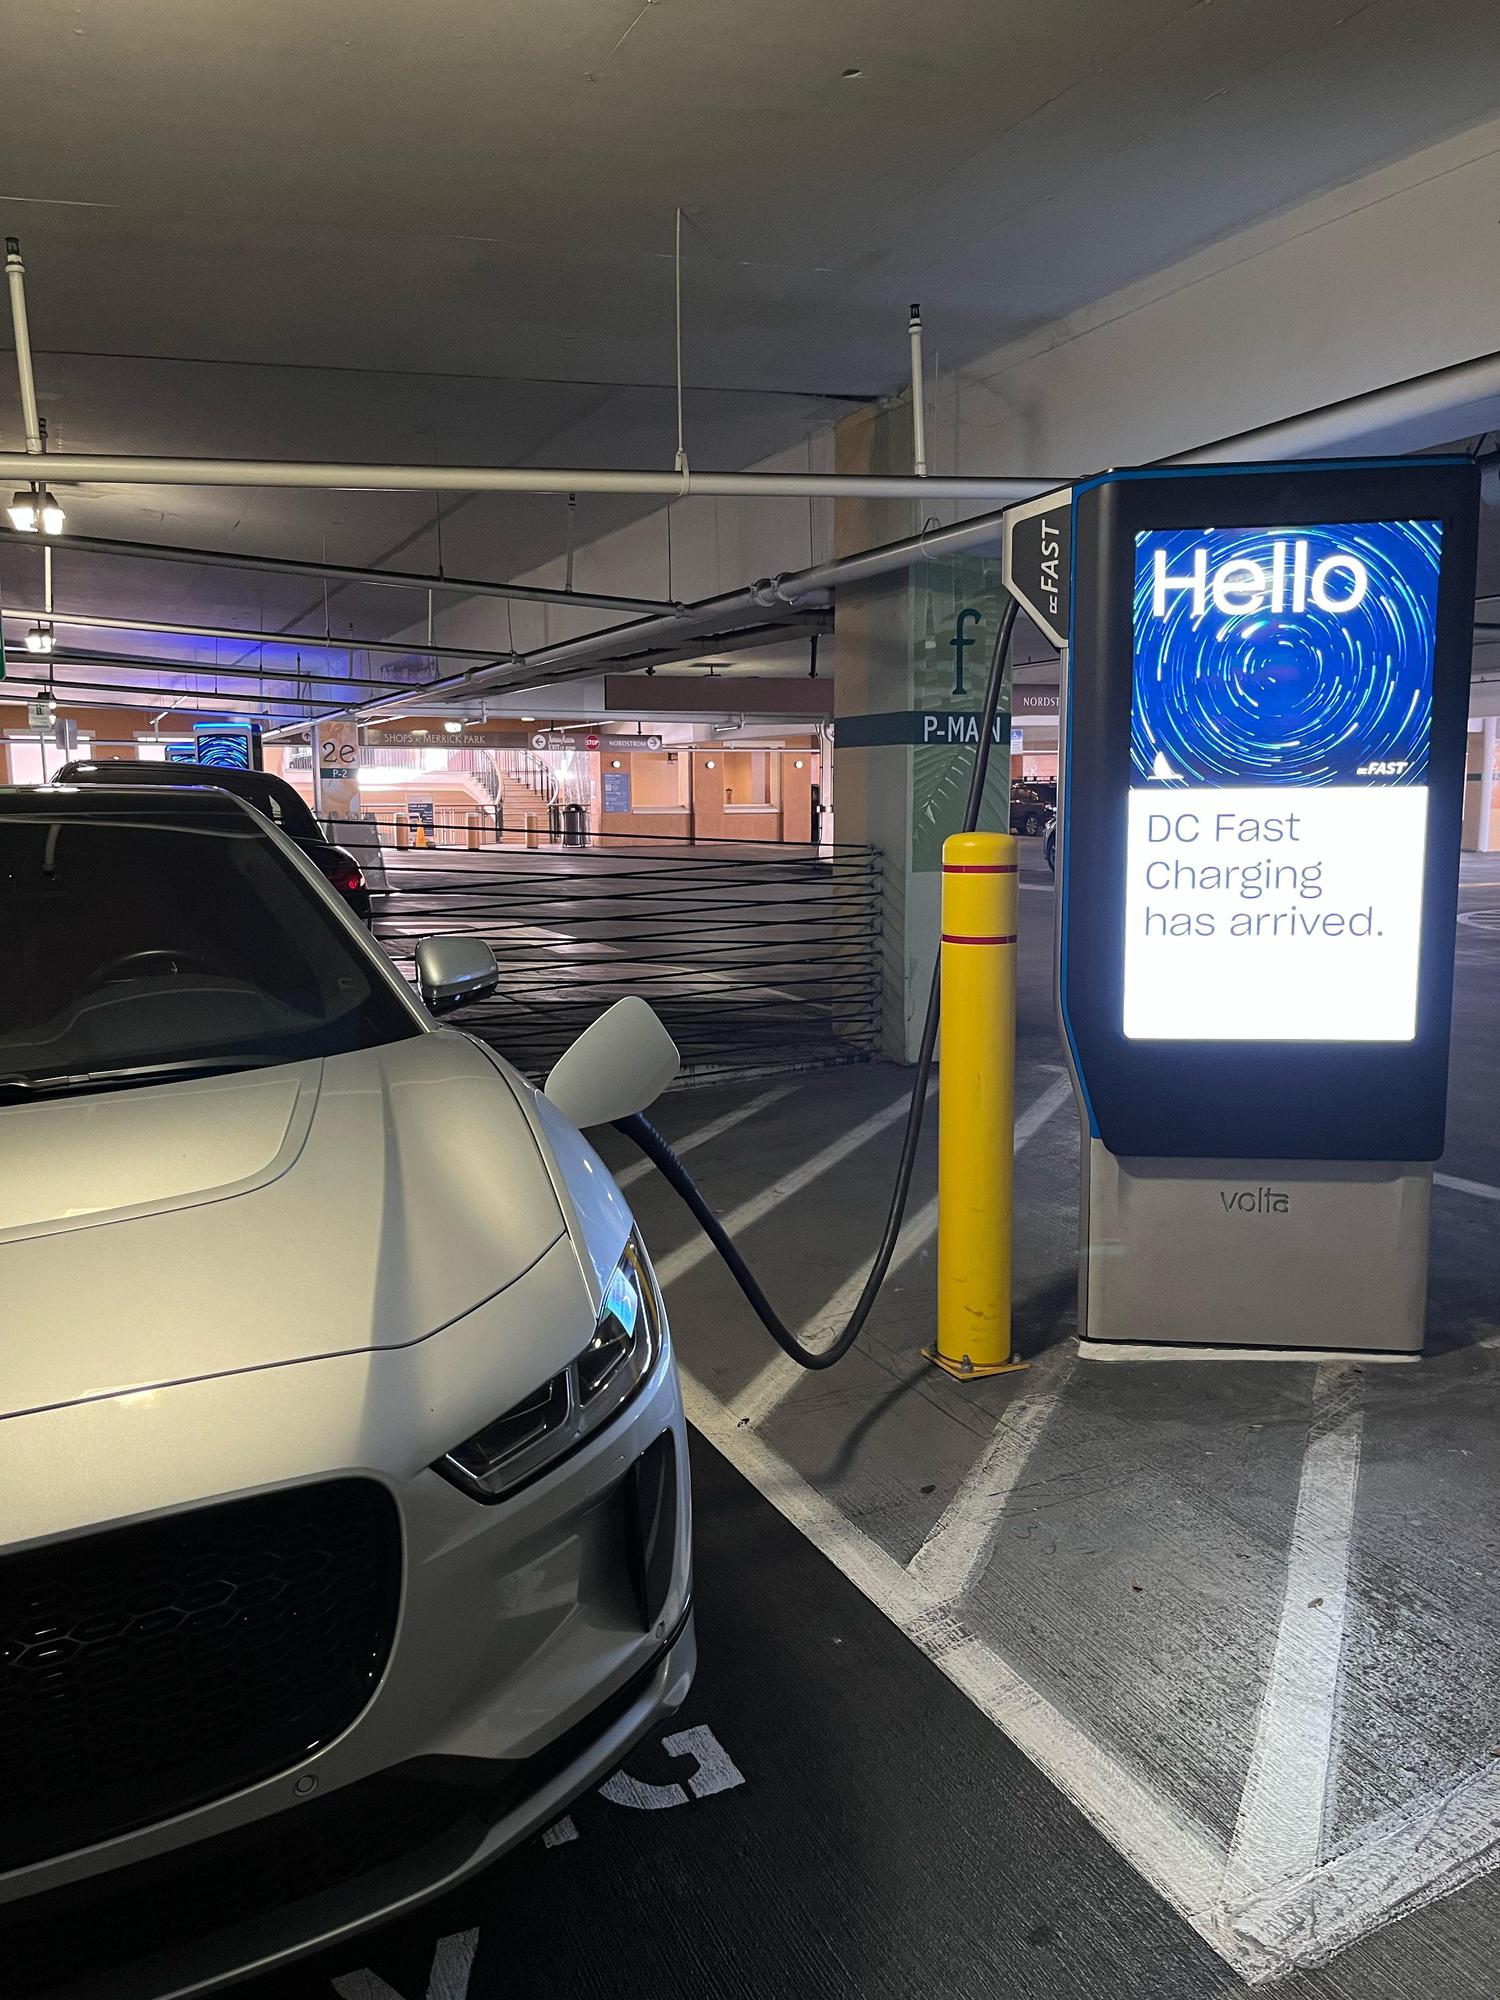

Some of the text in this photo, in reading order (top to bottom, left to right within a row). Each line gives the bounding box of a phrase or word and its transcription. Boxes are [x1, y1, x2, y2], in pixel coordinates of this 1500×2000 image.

[1040, 519, 1060, 593] FAST
[1152, 540, 1369, 617] Hello
[384, 733, 413, 743] SHOPS
[423, 734, 461, 744] MERRICK
[464, 735, 486, 744] PARK
[924, 715, 1000, 743] P-MAN
[332, 769, 347, 778] P-2
[1367, 761, 1408, 775] FAST
[1147, 812, 1300, 842] DC Fast
[1145, 859, 1323, 899] Charging
[1144, 905, 1384, 937] has arrived.
[1220, 1187, 1289, 1213] volta
